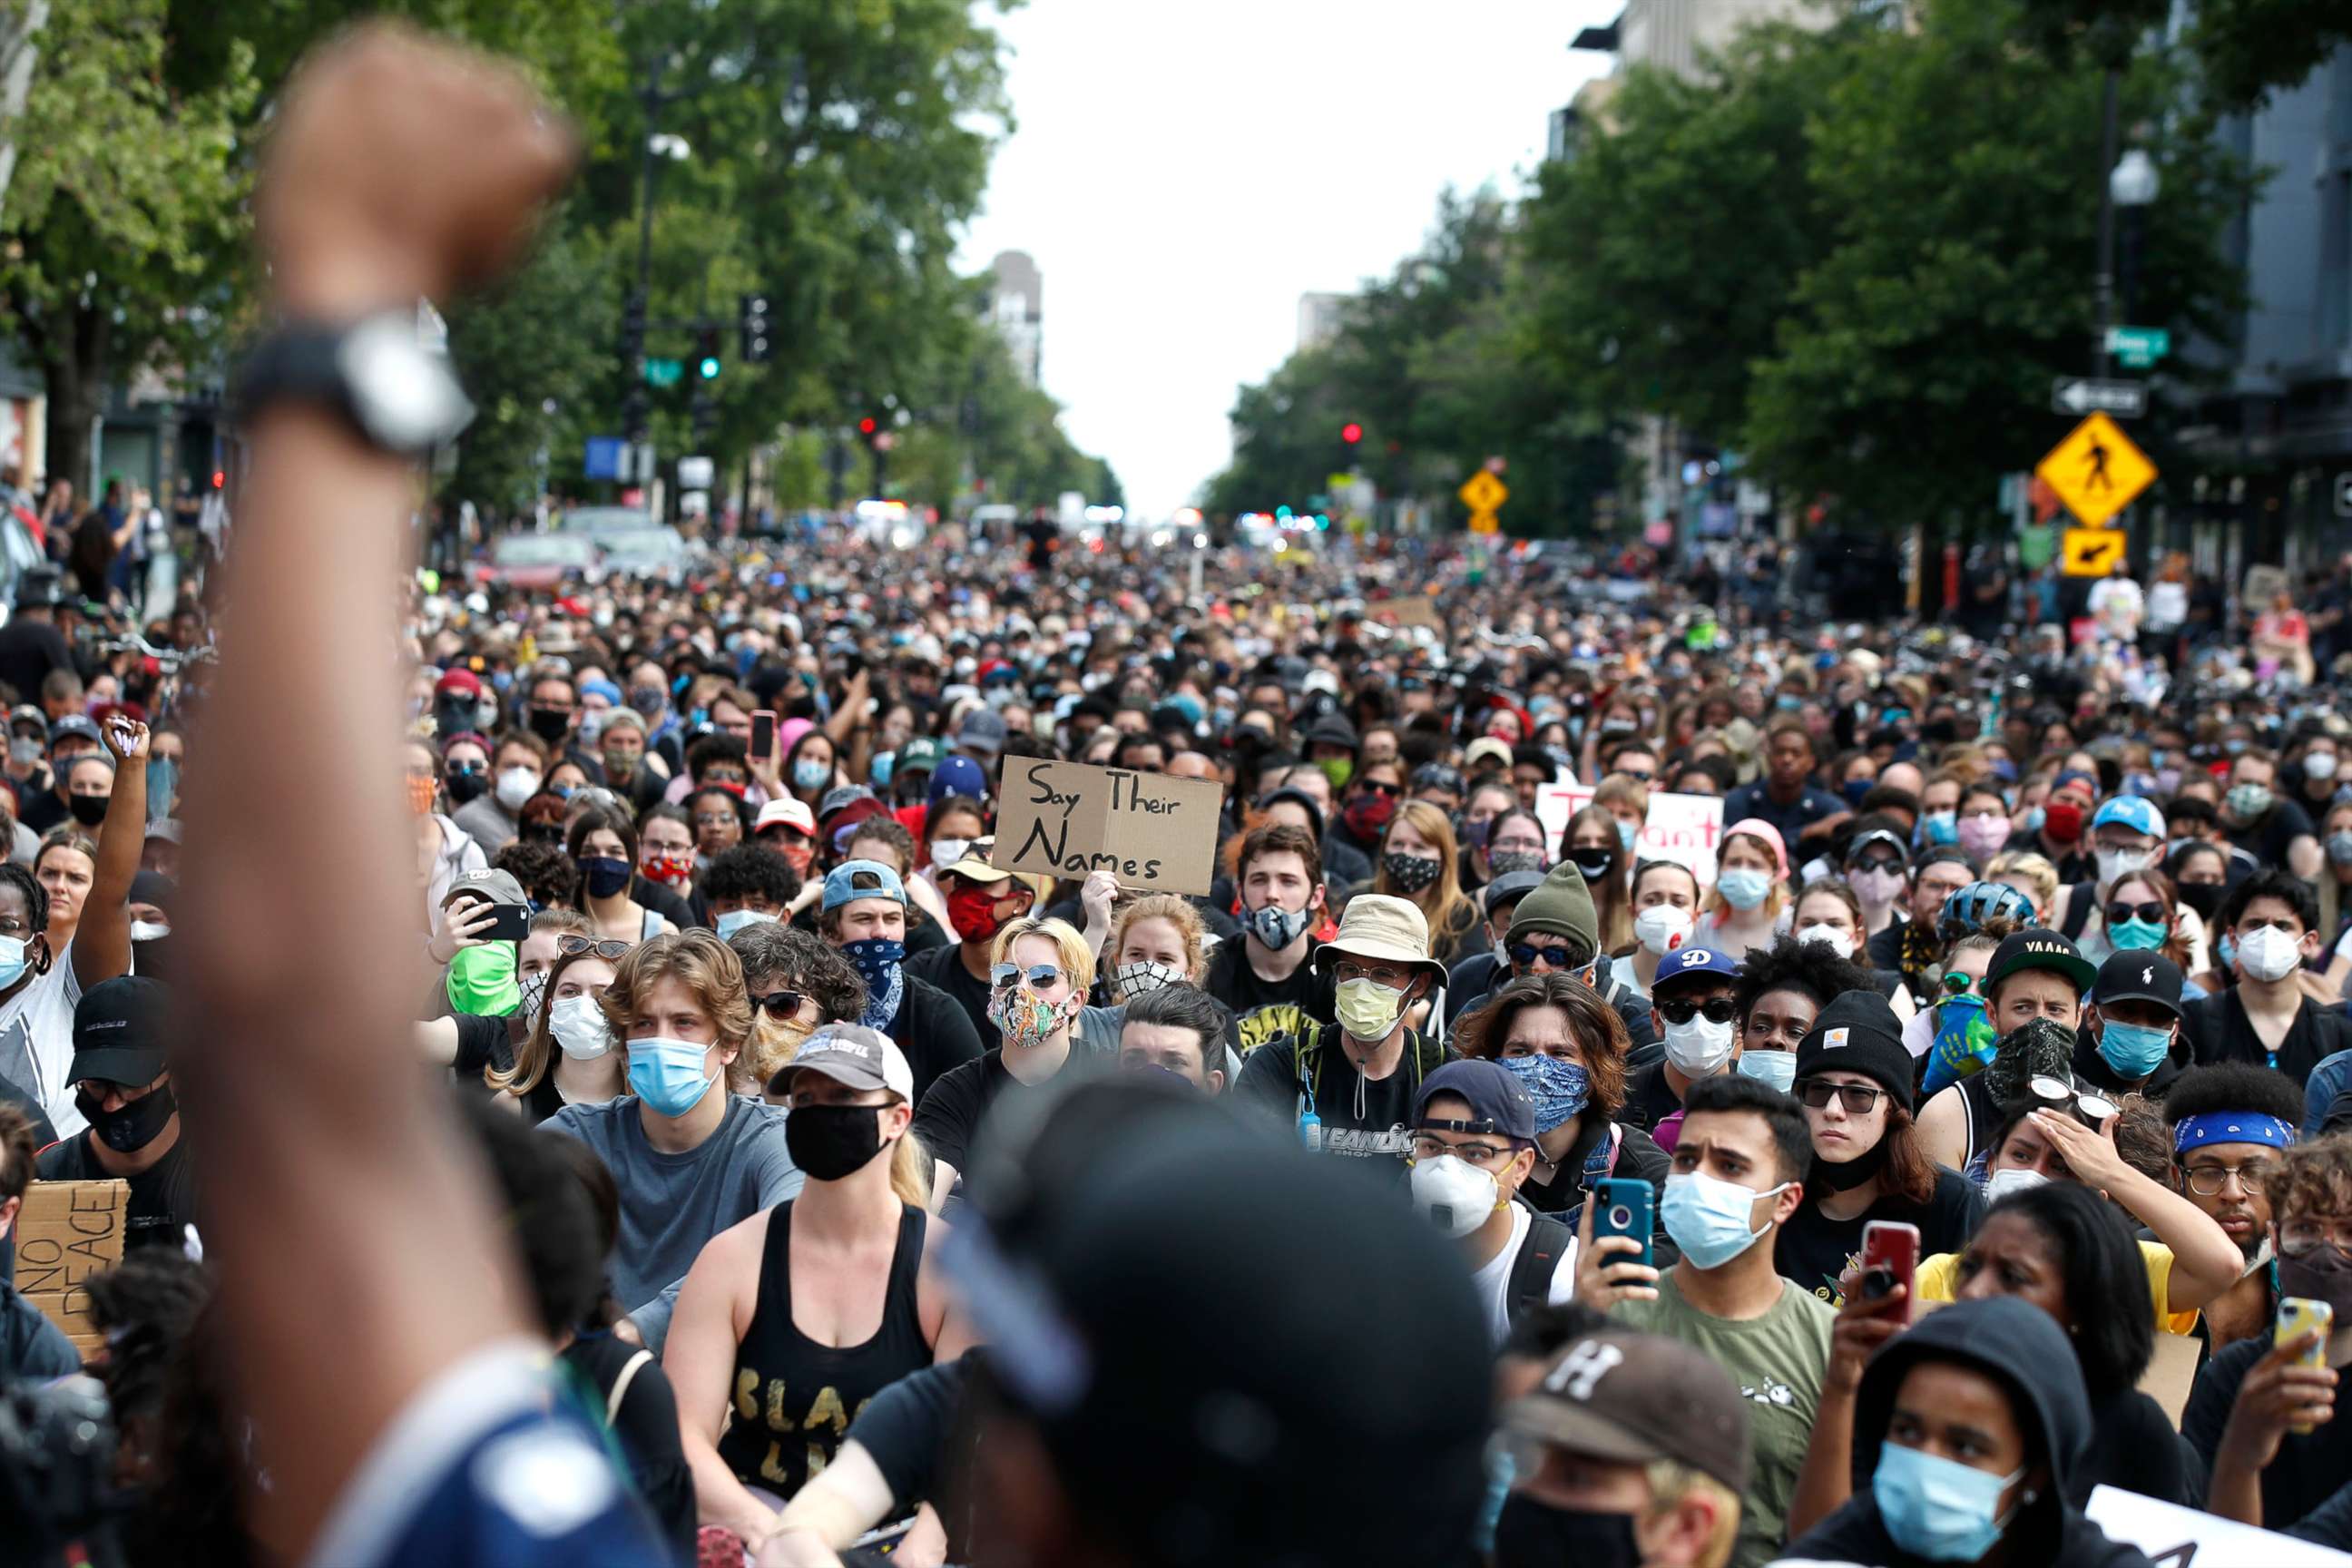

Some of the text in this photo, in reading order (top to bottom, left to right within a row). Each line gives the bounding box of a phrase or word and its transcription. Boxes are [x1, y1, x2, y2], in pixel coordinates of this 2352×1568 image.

[1027, 763, 1181, 818] Say Their
[1012, 817, 1162, 879] Names
[1642, 812, 1720, 848] an't
[1681, 949, 1712, 967] D
[1321, 1122, 1415, 1153] LEANLIN
[15, 1239, 64, 1294] NO
[1544, 1339, 1623, 1401] H
